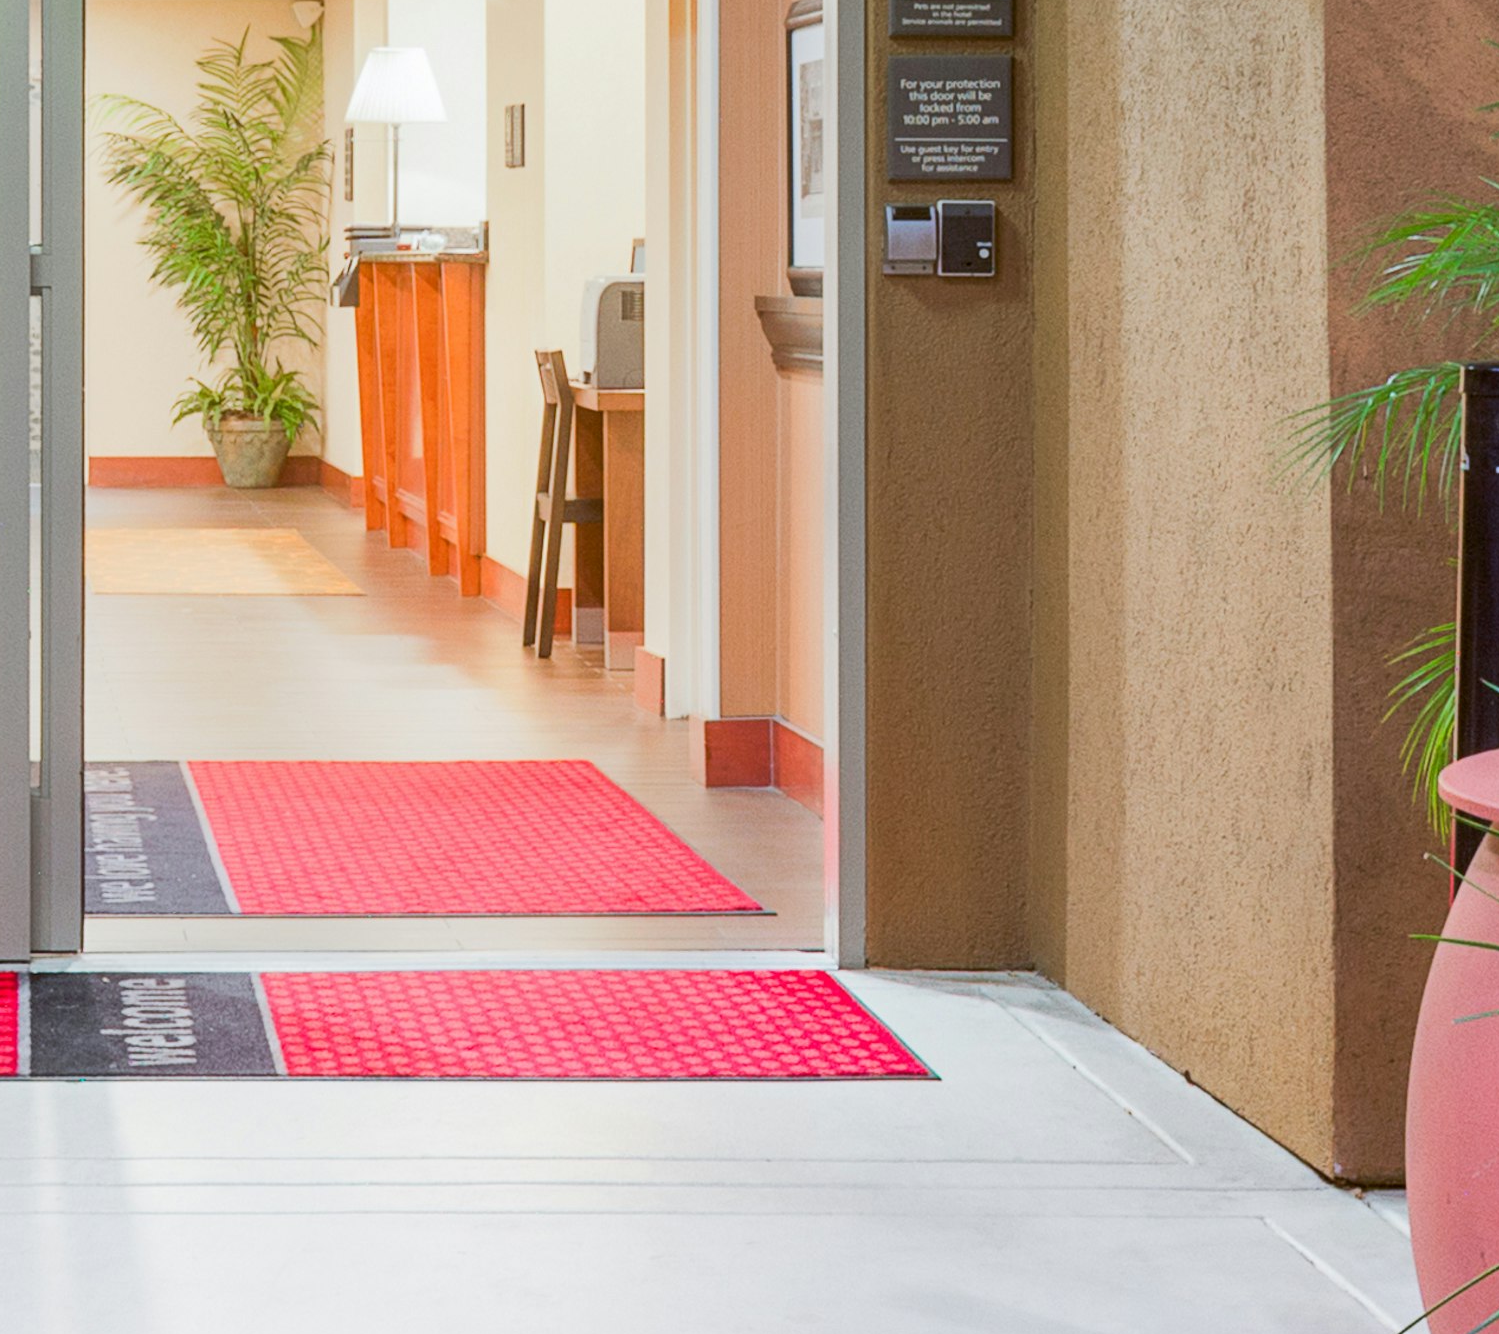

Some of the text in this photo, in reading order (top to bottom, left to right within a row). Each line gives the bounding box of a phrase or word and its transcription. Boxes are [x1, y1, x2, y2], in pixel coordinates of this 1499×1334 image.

[940, 10, 952, 18] the
[900, 79, 1001, 92] For your protection
[909, 91, 992, 101] this door will be
[919, 103, 982, 113] locked from
[931, 117, 949, 127] pm
[982, 116, 999, 125] am
[900, 145, 999, 155] Use guest key for entry
[911, 154, 985, 164] or press intercom
[921, 163, 978, 172] for assistance
[84, 814, 158, 853] having
[84, 853, 151, 880] love
[100, 881, 156, 904] we
[100, 978, 197, 1067] welcome
